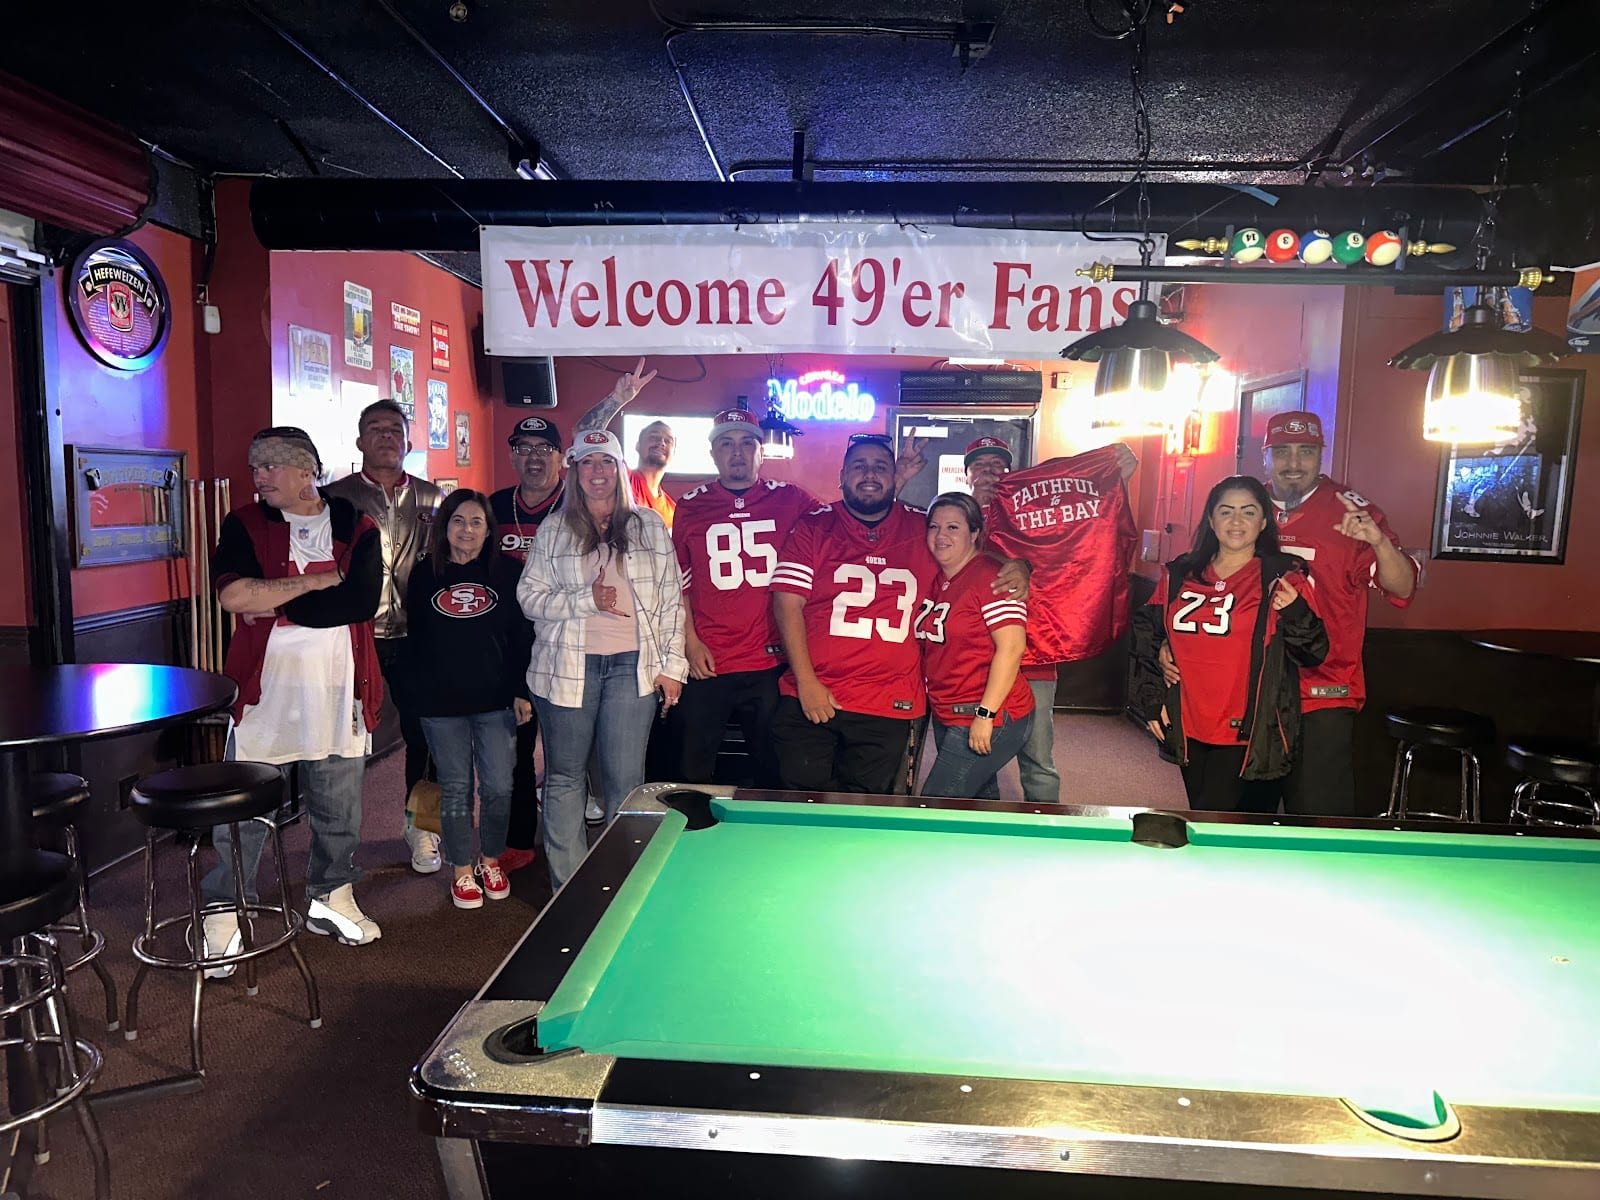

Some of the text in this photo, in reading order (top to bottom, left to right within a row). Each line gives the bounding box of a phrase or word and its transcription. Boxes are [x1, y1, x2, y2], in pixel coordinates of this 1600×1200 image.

[93, 267, 145, 293] HEFEWEIZEN
[505, 255, 1137, 332] Welcome 49'er Fans
[767, 379, 876, 422] Modelo
[941, 466, 964, 474] EMERGEN
[1012, 477, 1100, 512] FAITHFUL
[1015, 500, 1100, 531] THE BAY
[1454, 529, 1499, 540] JOHNNIE
[706, 519, 778, 591] 85
[451, 588, 486, 613] SF
[829, 563, 918, 644] 23
[1172, 590, 1234, 635] 23
[914, 598, 951, 645] 23
